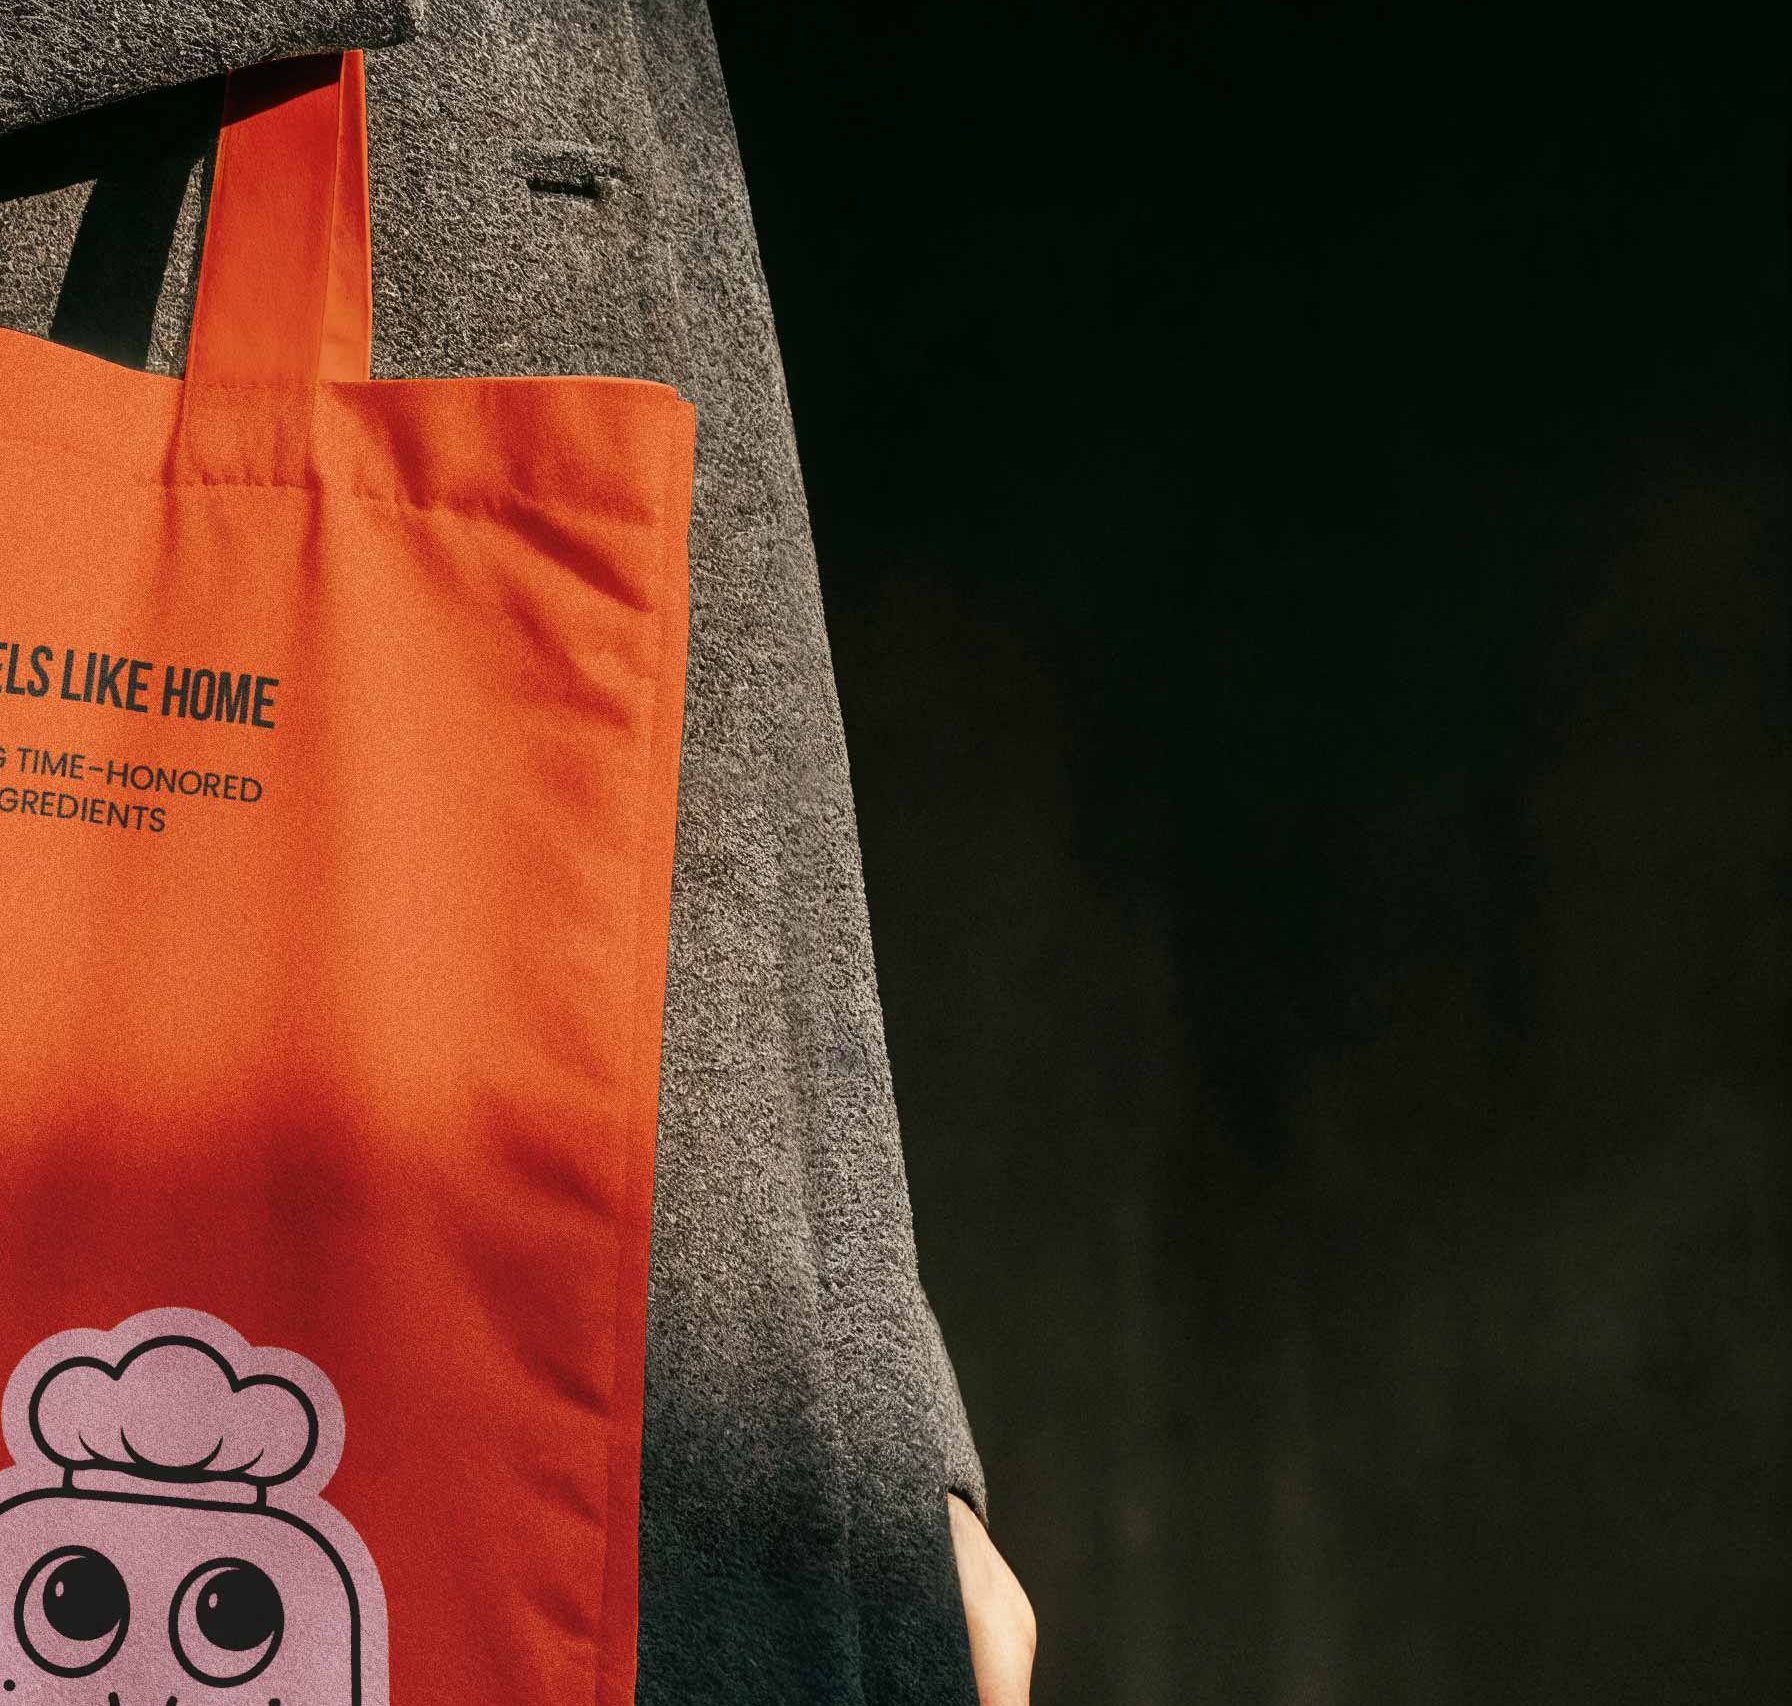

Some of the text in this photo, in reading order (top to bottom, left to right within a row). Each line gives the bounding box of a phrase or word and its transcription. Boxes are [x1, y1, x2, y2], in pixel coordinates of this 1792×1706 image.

[60, 649, 153, 713] LIKE
[160, 666, 279, 730] HOME
[16, 746, 264, 804] TIME-HONORED
